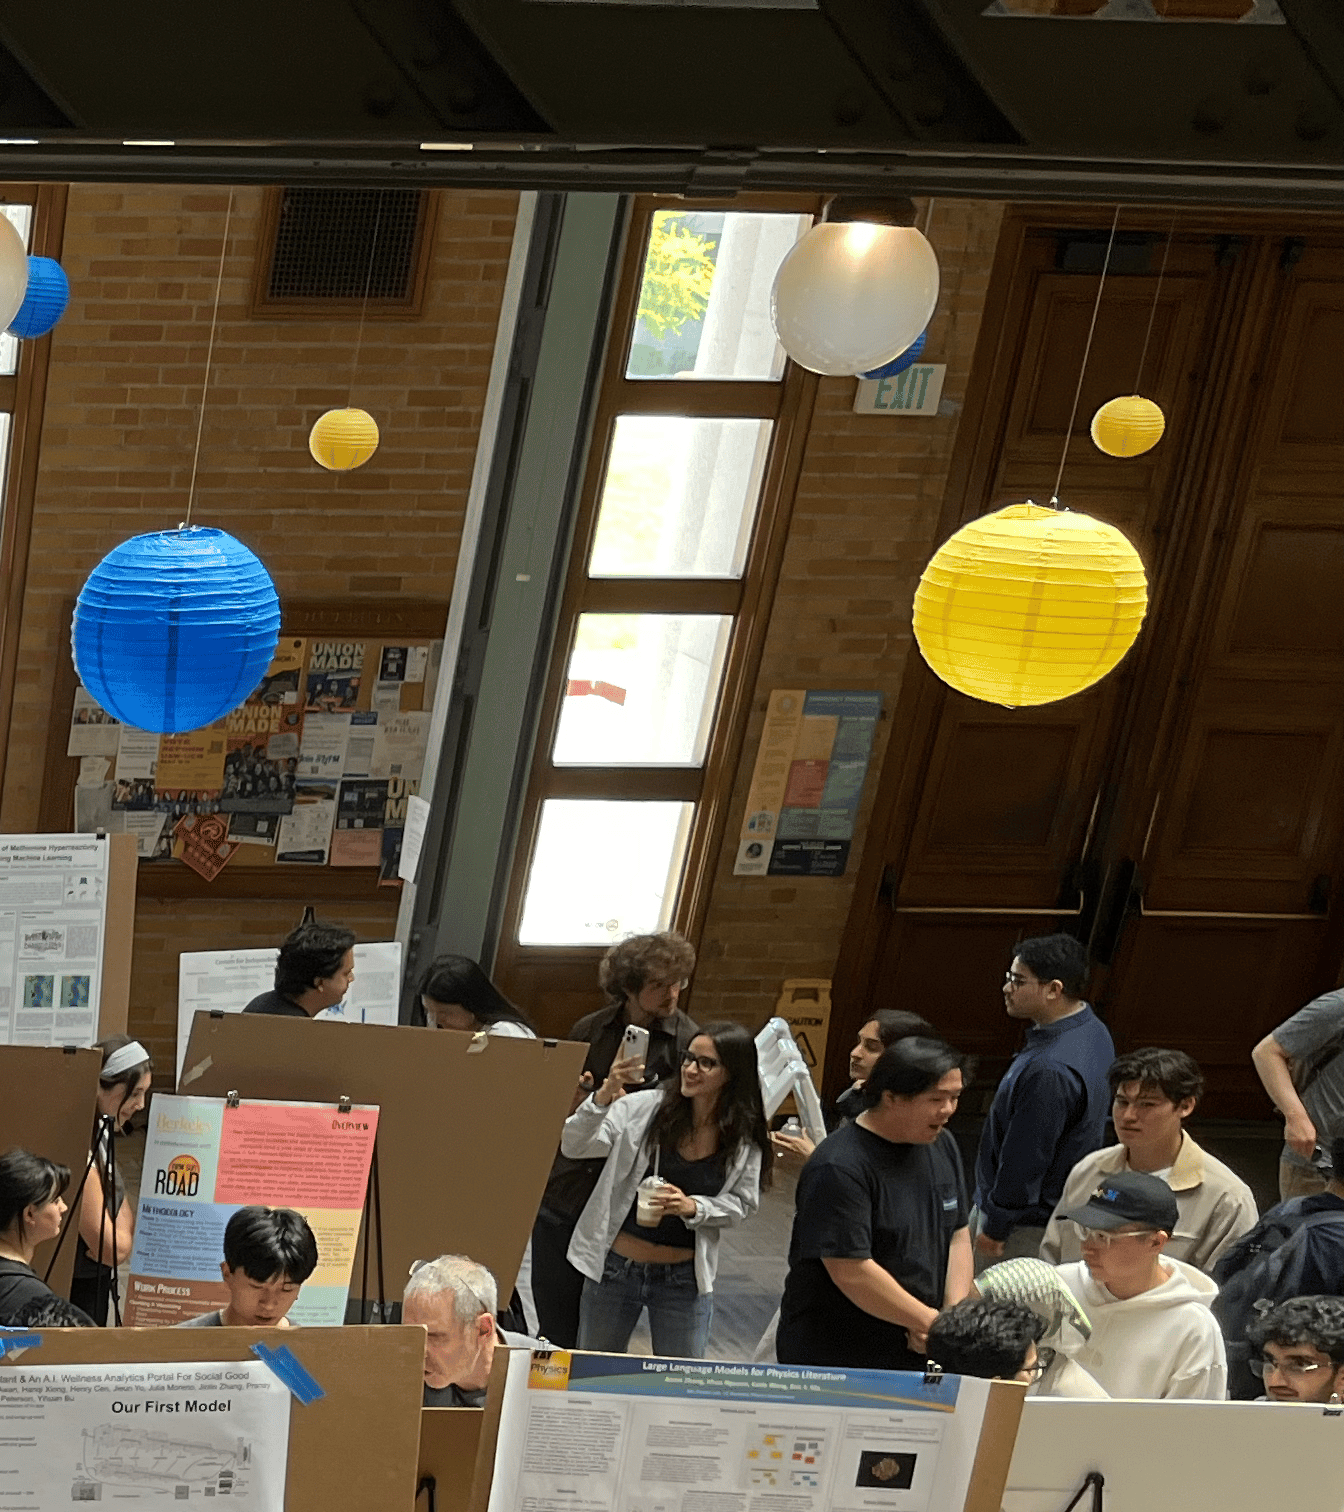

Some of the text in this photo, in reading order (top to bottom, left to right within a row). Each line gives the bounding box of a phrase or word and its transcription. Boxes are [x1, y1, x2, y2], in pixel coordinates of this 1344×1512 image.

[874, 367, 934, 410] EXIT
[312, 643, 365, 656] UNION
[310, 656, 363, 669] MADE
[226, 720, 279, 733] MADE
[155, 1169, 199, 1196] ROAD
[531, 1363, 568, 1375] Physics
[643, 1361, 847, 1381] Large Language Models for Physics Literature
[19, 1375, 26, 1383] &
[28, 1374, 42, 1382] An
[61, 1374, 102, 1382] Wellness
[104, 1373, 145, 1383] Analytics
[147, 1373, 174, 1381] Portal
[175, 1372, 191, 1380] For
[194, 1372, 223, 1380] Social
[225, 1371, 249, 1380] Good
[70, 1385, 91, 1394] Henry
[112, 1399, 231, 1413] Our First Model
